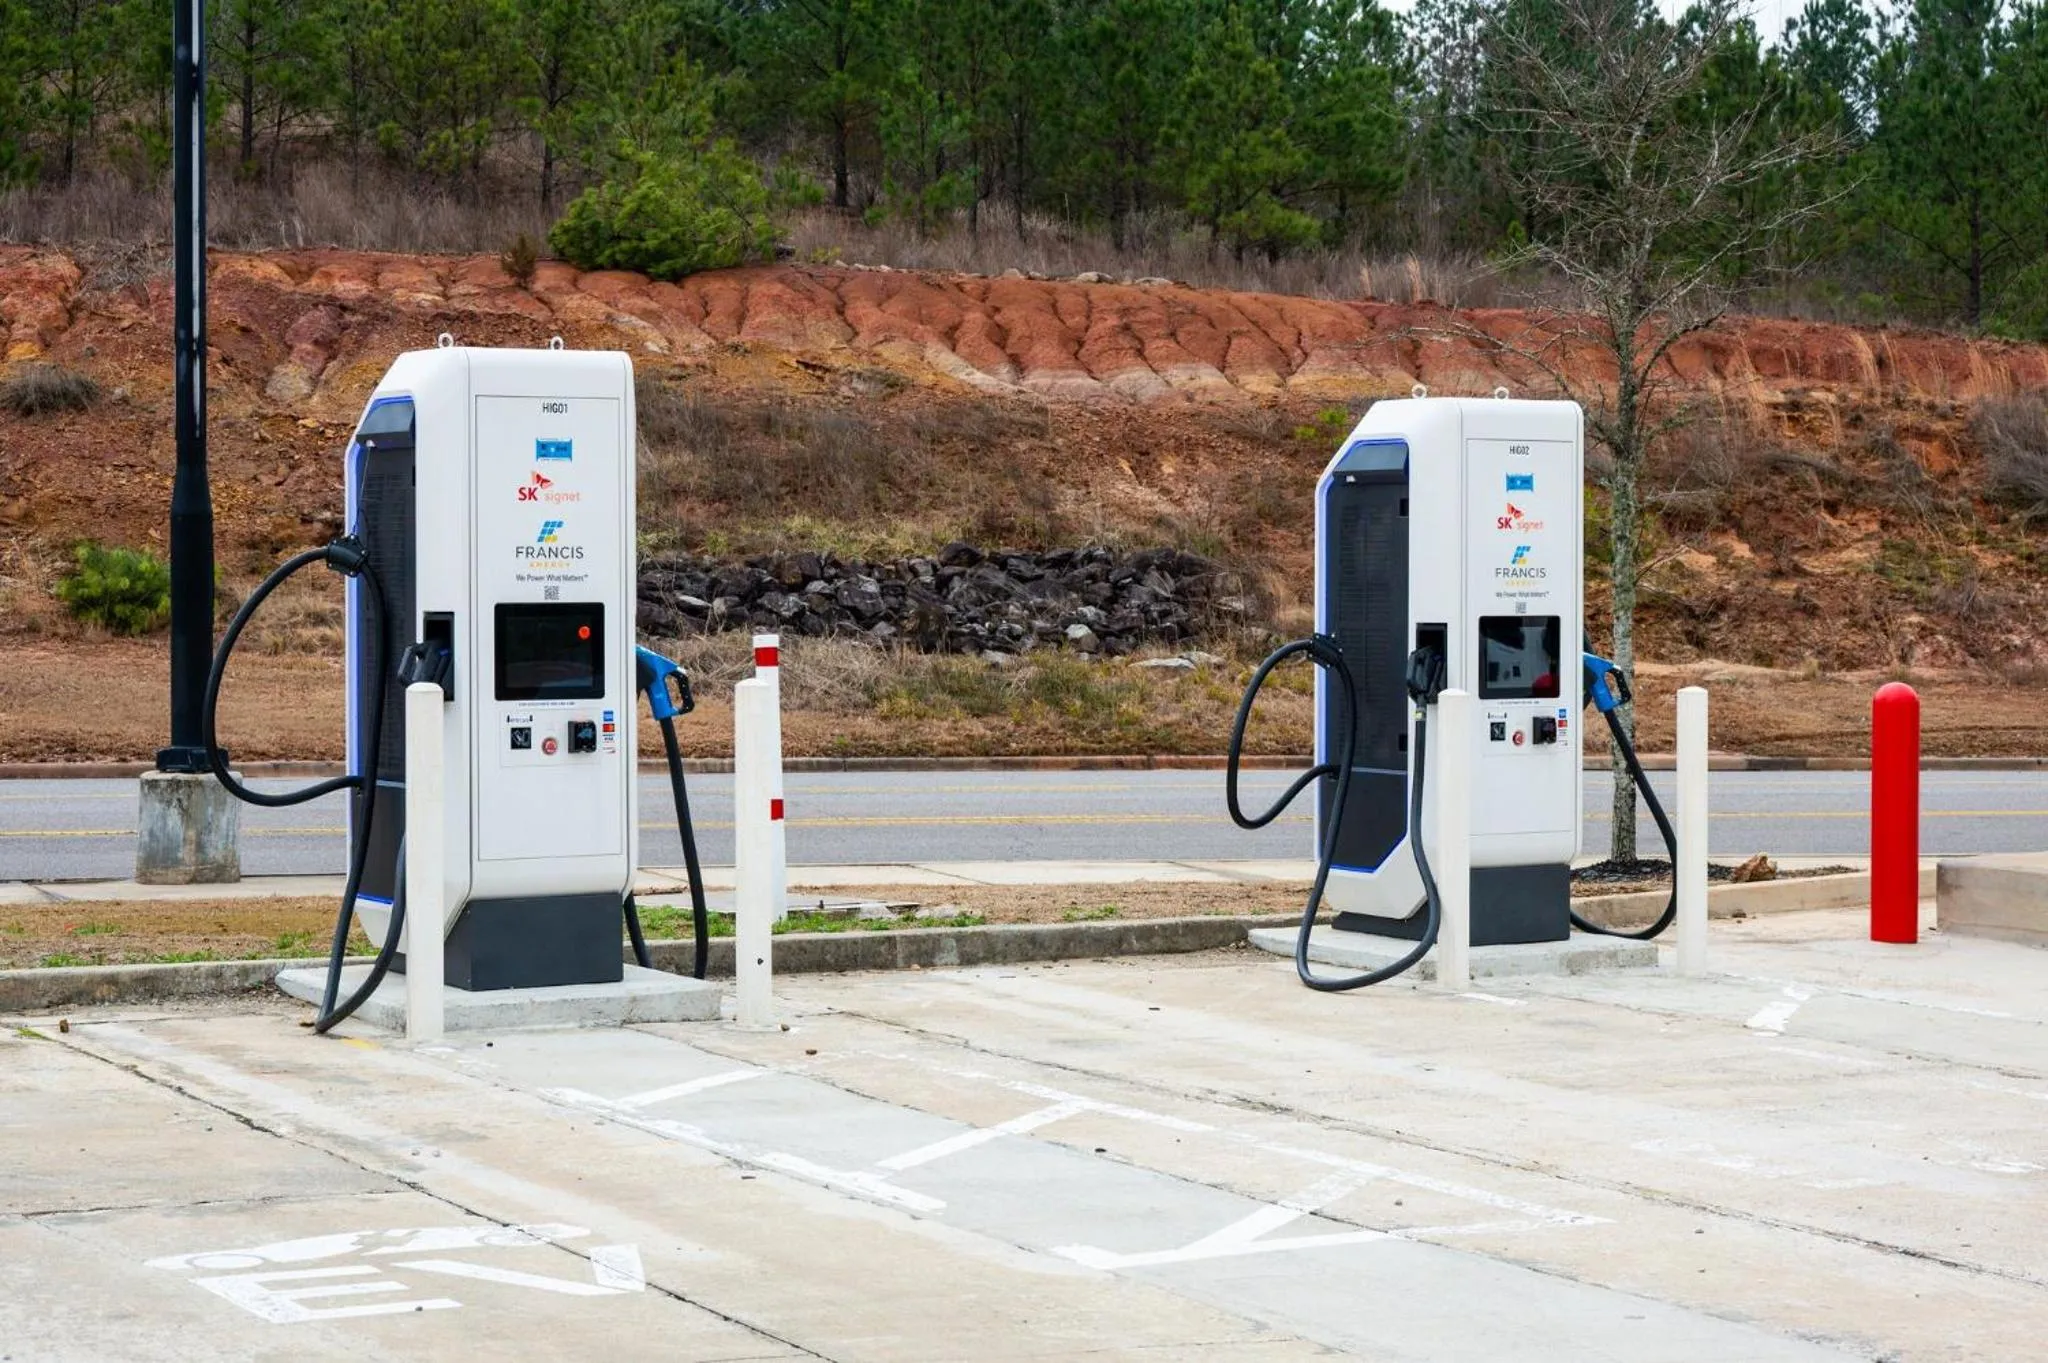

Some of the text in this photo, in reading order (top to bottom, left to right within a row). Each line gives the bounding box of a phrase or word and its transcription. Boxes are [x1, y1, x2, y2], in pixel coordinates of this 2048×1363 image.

[543, 402, 568, 413] HIG01
[518, 487, 580, 503] SK signet
[1497, 516, 1513, 529] SK
[515, 546, 584, 559] FRANCIS
[1495, 567, 1547, 578] FRANCIS
[189, 1243, 646, 1324] EV
